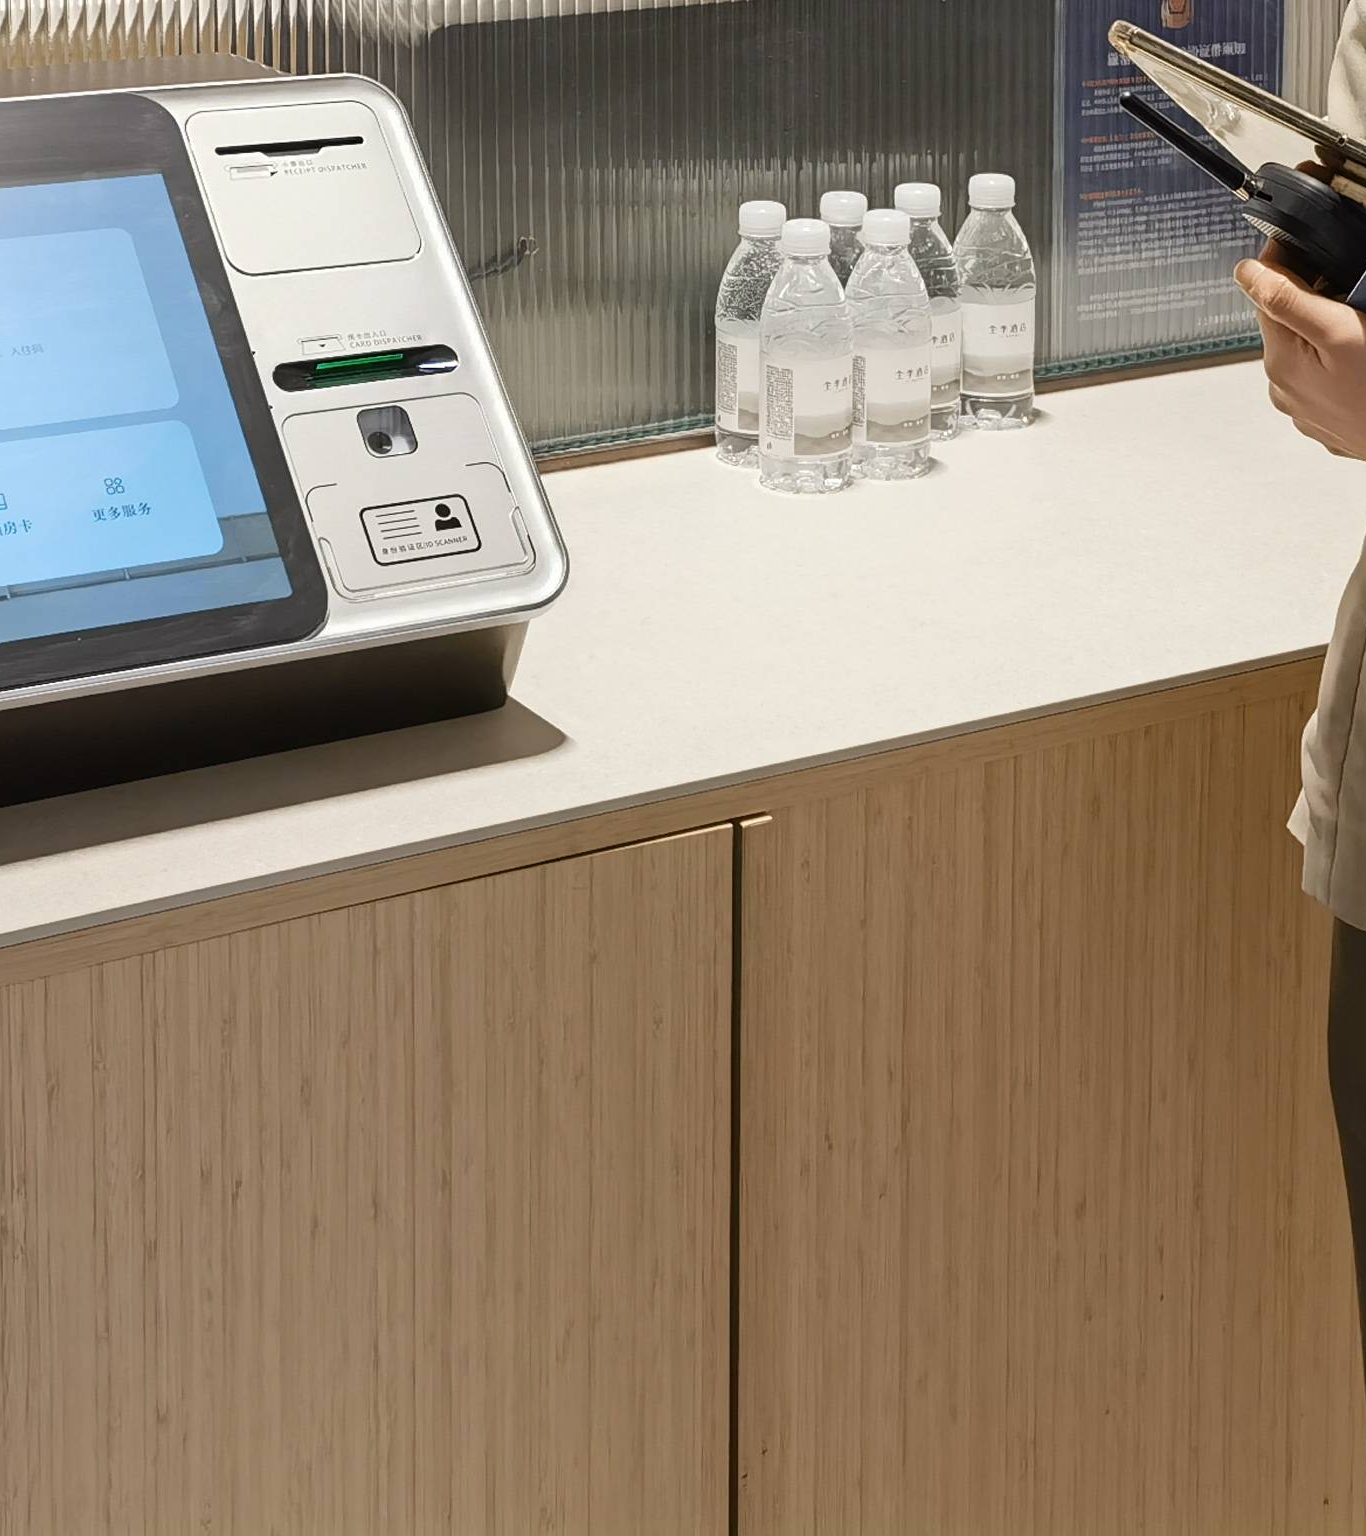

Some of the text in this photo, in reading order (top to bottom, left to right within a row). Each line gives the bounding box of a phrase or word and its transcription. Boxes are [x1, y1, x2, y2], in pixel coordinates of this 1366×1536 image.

[318, 163, 367, 173] DISPATCHER
[93, 502, 151, 522] 更多服务
[435, 536, 468, 547] SCANNER
